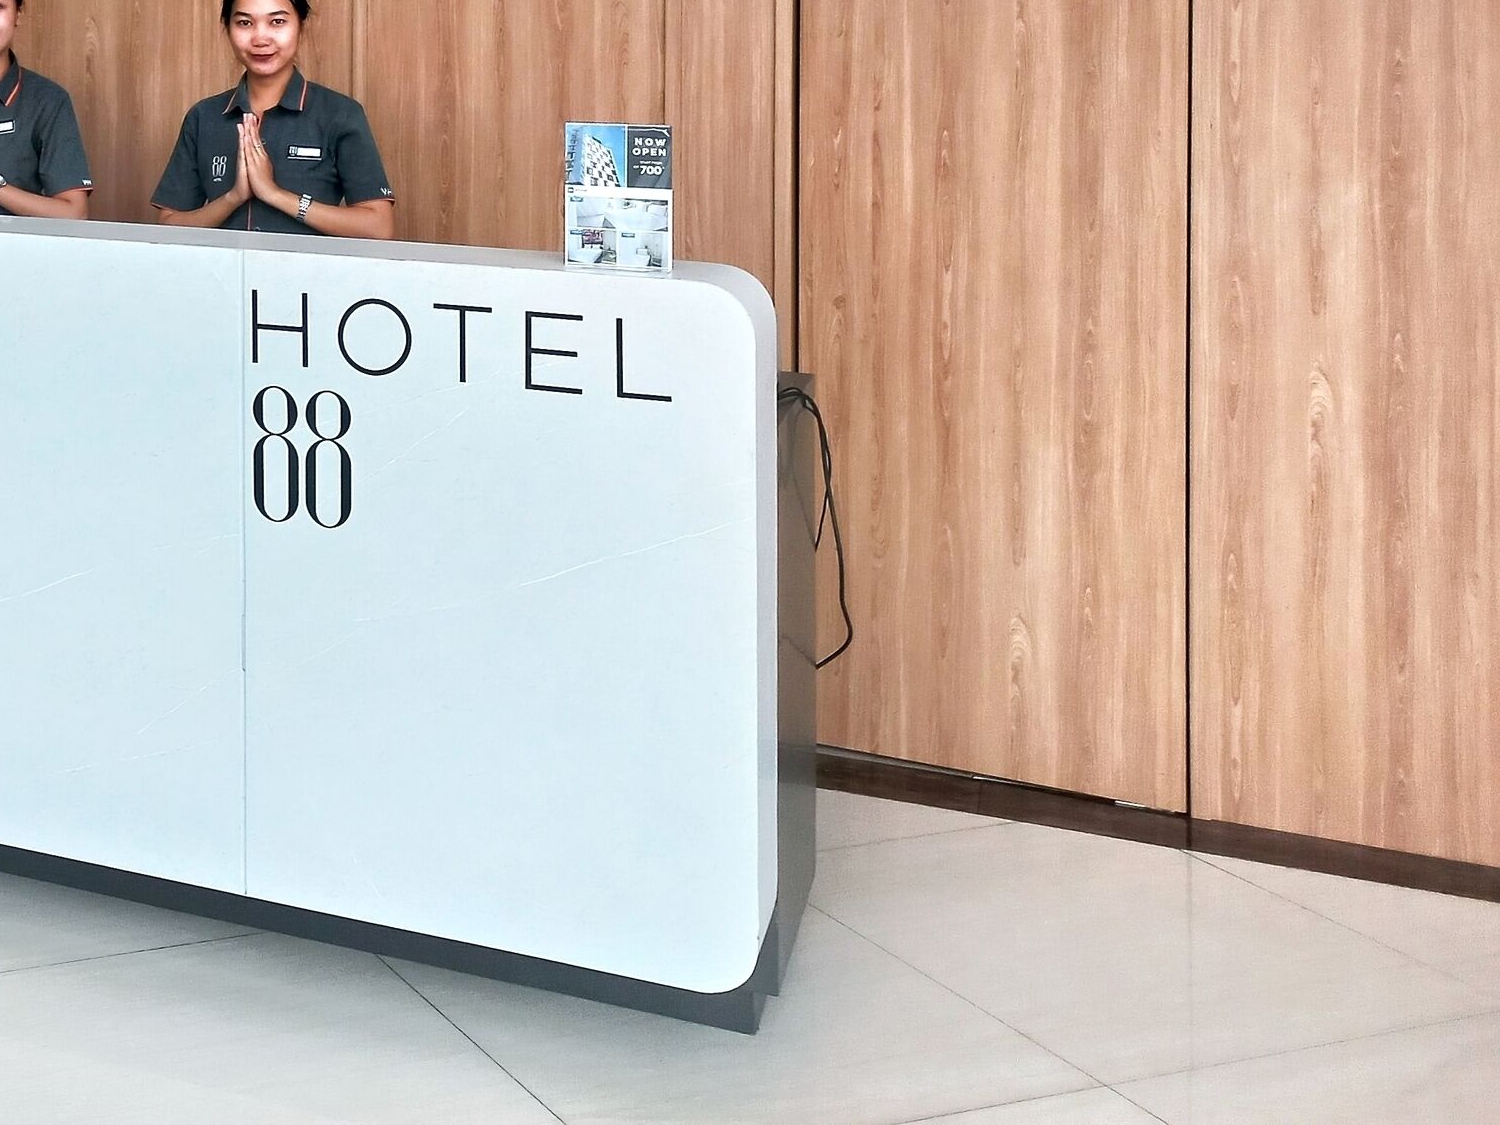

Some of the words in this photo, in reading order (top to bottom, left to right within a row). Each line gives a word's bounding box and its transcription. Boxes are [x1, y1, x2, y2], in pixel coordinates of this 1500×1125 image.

[632, 147, 667, 157] OPEN
[634, 137, 666, 147] NOW
[211, 155, 227, 177] 88
[252, 289, 673, 403] HOTEL
[253, 385, 352, 529] 88
